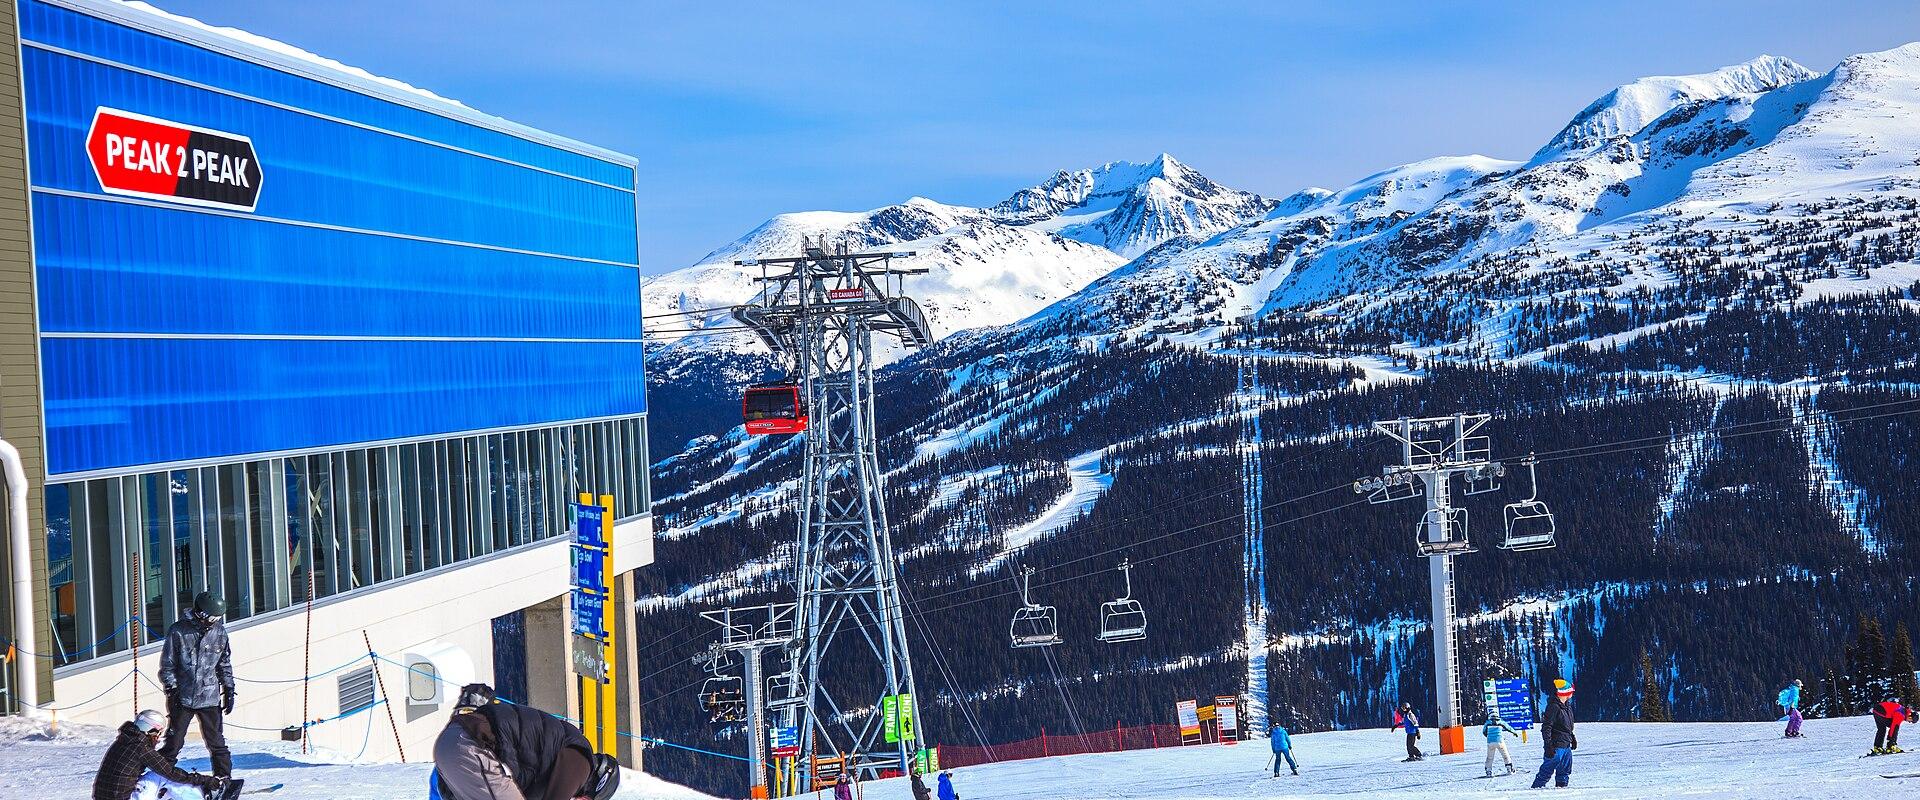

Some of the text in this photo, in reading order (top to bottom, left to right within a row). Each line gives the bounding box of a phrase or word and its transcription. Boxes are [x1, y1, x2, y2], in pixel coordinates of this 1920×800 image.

[106, 133, 250, 188] PEAK 2 PEAK
[886, 699, 896, 733] FAMILY
[904, 694, 912, 717] ZONE
